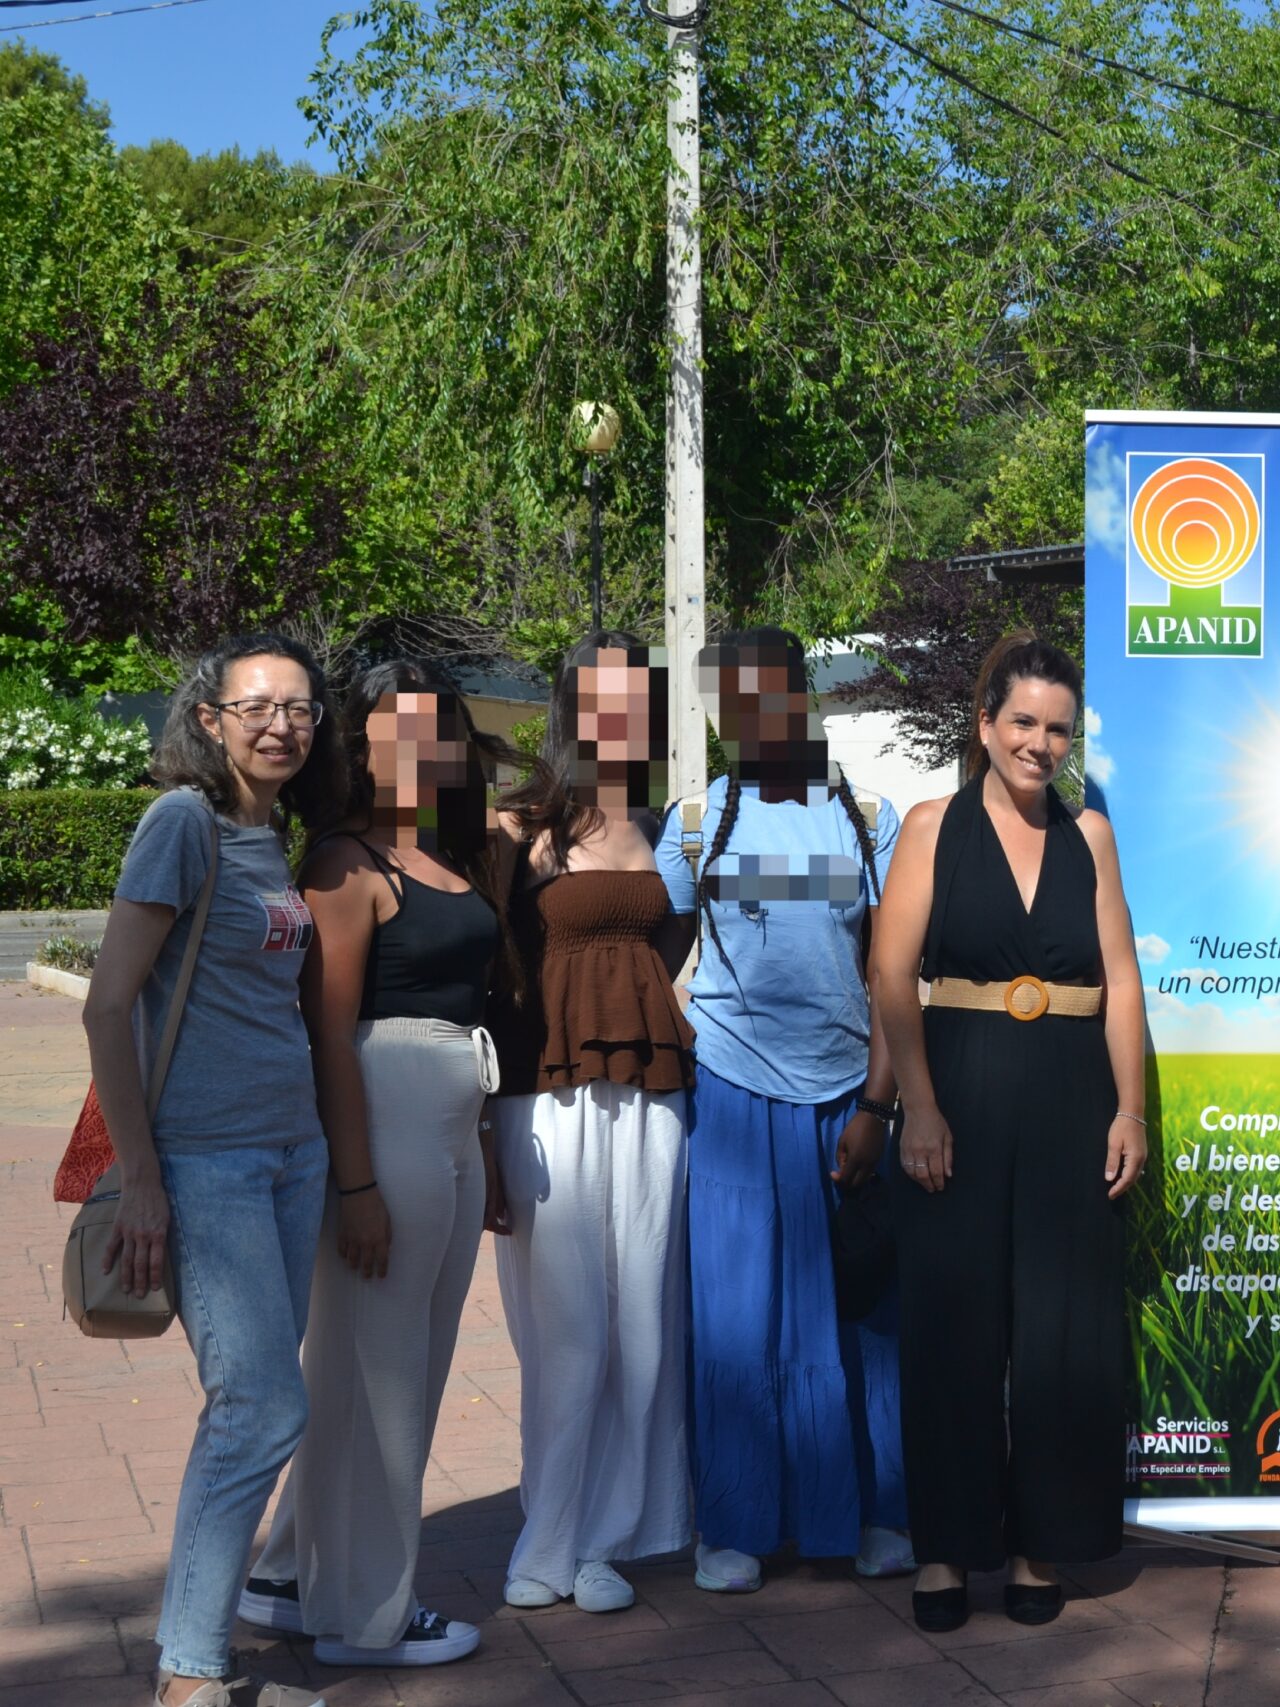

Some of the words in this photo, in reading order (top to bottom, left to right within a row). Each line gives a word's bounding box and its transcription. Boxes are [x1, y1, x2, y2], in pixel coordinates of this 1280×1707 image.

[1133, 616, 1257, 646] APANID
[1158, 976, 1191, 994] un
[1175, 1143, 1200, 1171] el
[1181, 1191, 1198, 1218] y
[1208, 1184, 1232, 1211] el
[1202, 1224, 1235, 1251] de
[1245, 1224, 1280, 1251] las
[1245, 1311, 1262, 1338] y
[1157, 1416, 1229, 1432] Servicios
[1126, 1434, 1212, 1454] APANID
[1150, 1465, 1184, 1476] Especial
[1185, 1465, 1197, 1474] de
[1198, 1464, 1231, 1476] Empleo
